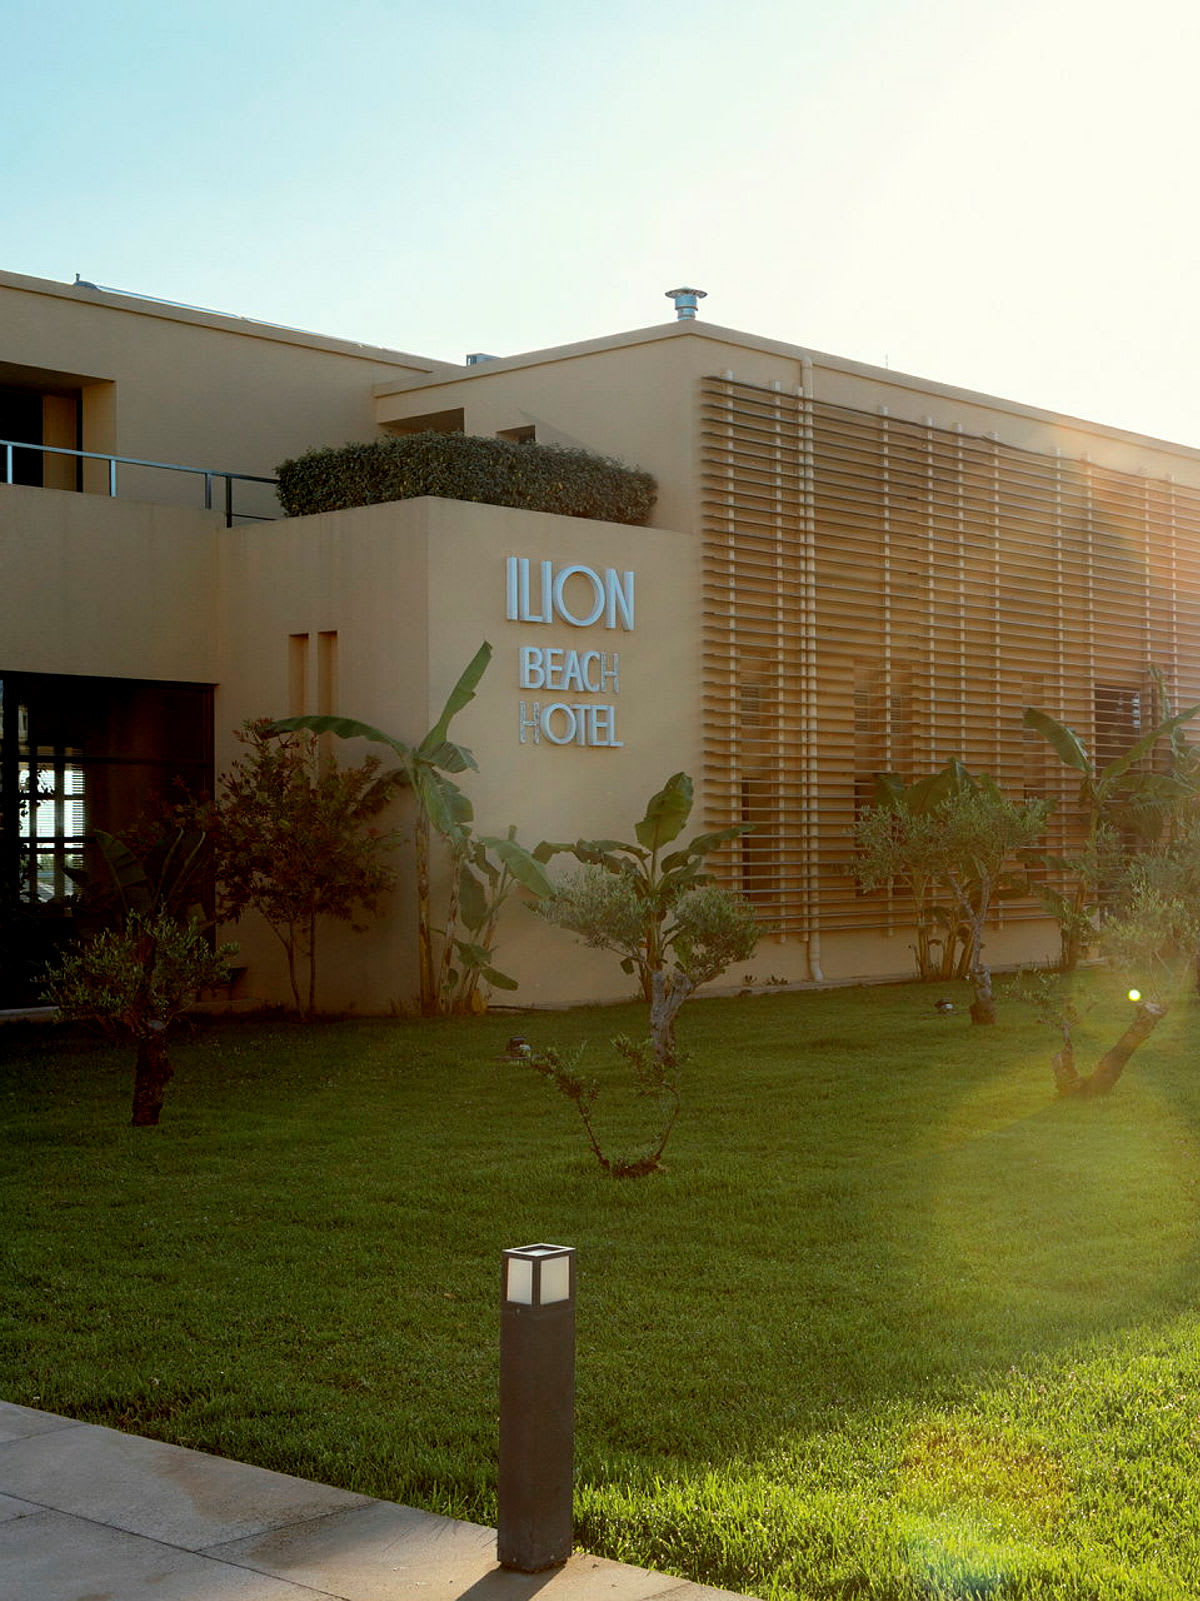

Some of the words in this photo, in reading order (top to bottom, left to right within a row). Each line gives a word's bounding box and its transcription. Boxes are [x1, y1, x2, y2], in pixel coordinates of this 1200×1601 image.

[506, 556, 635, 631] ILION
[520, 646, 619, 693] BEACH
[520, 701, 624, 747] HOTEL
